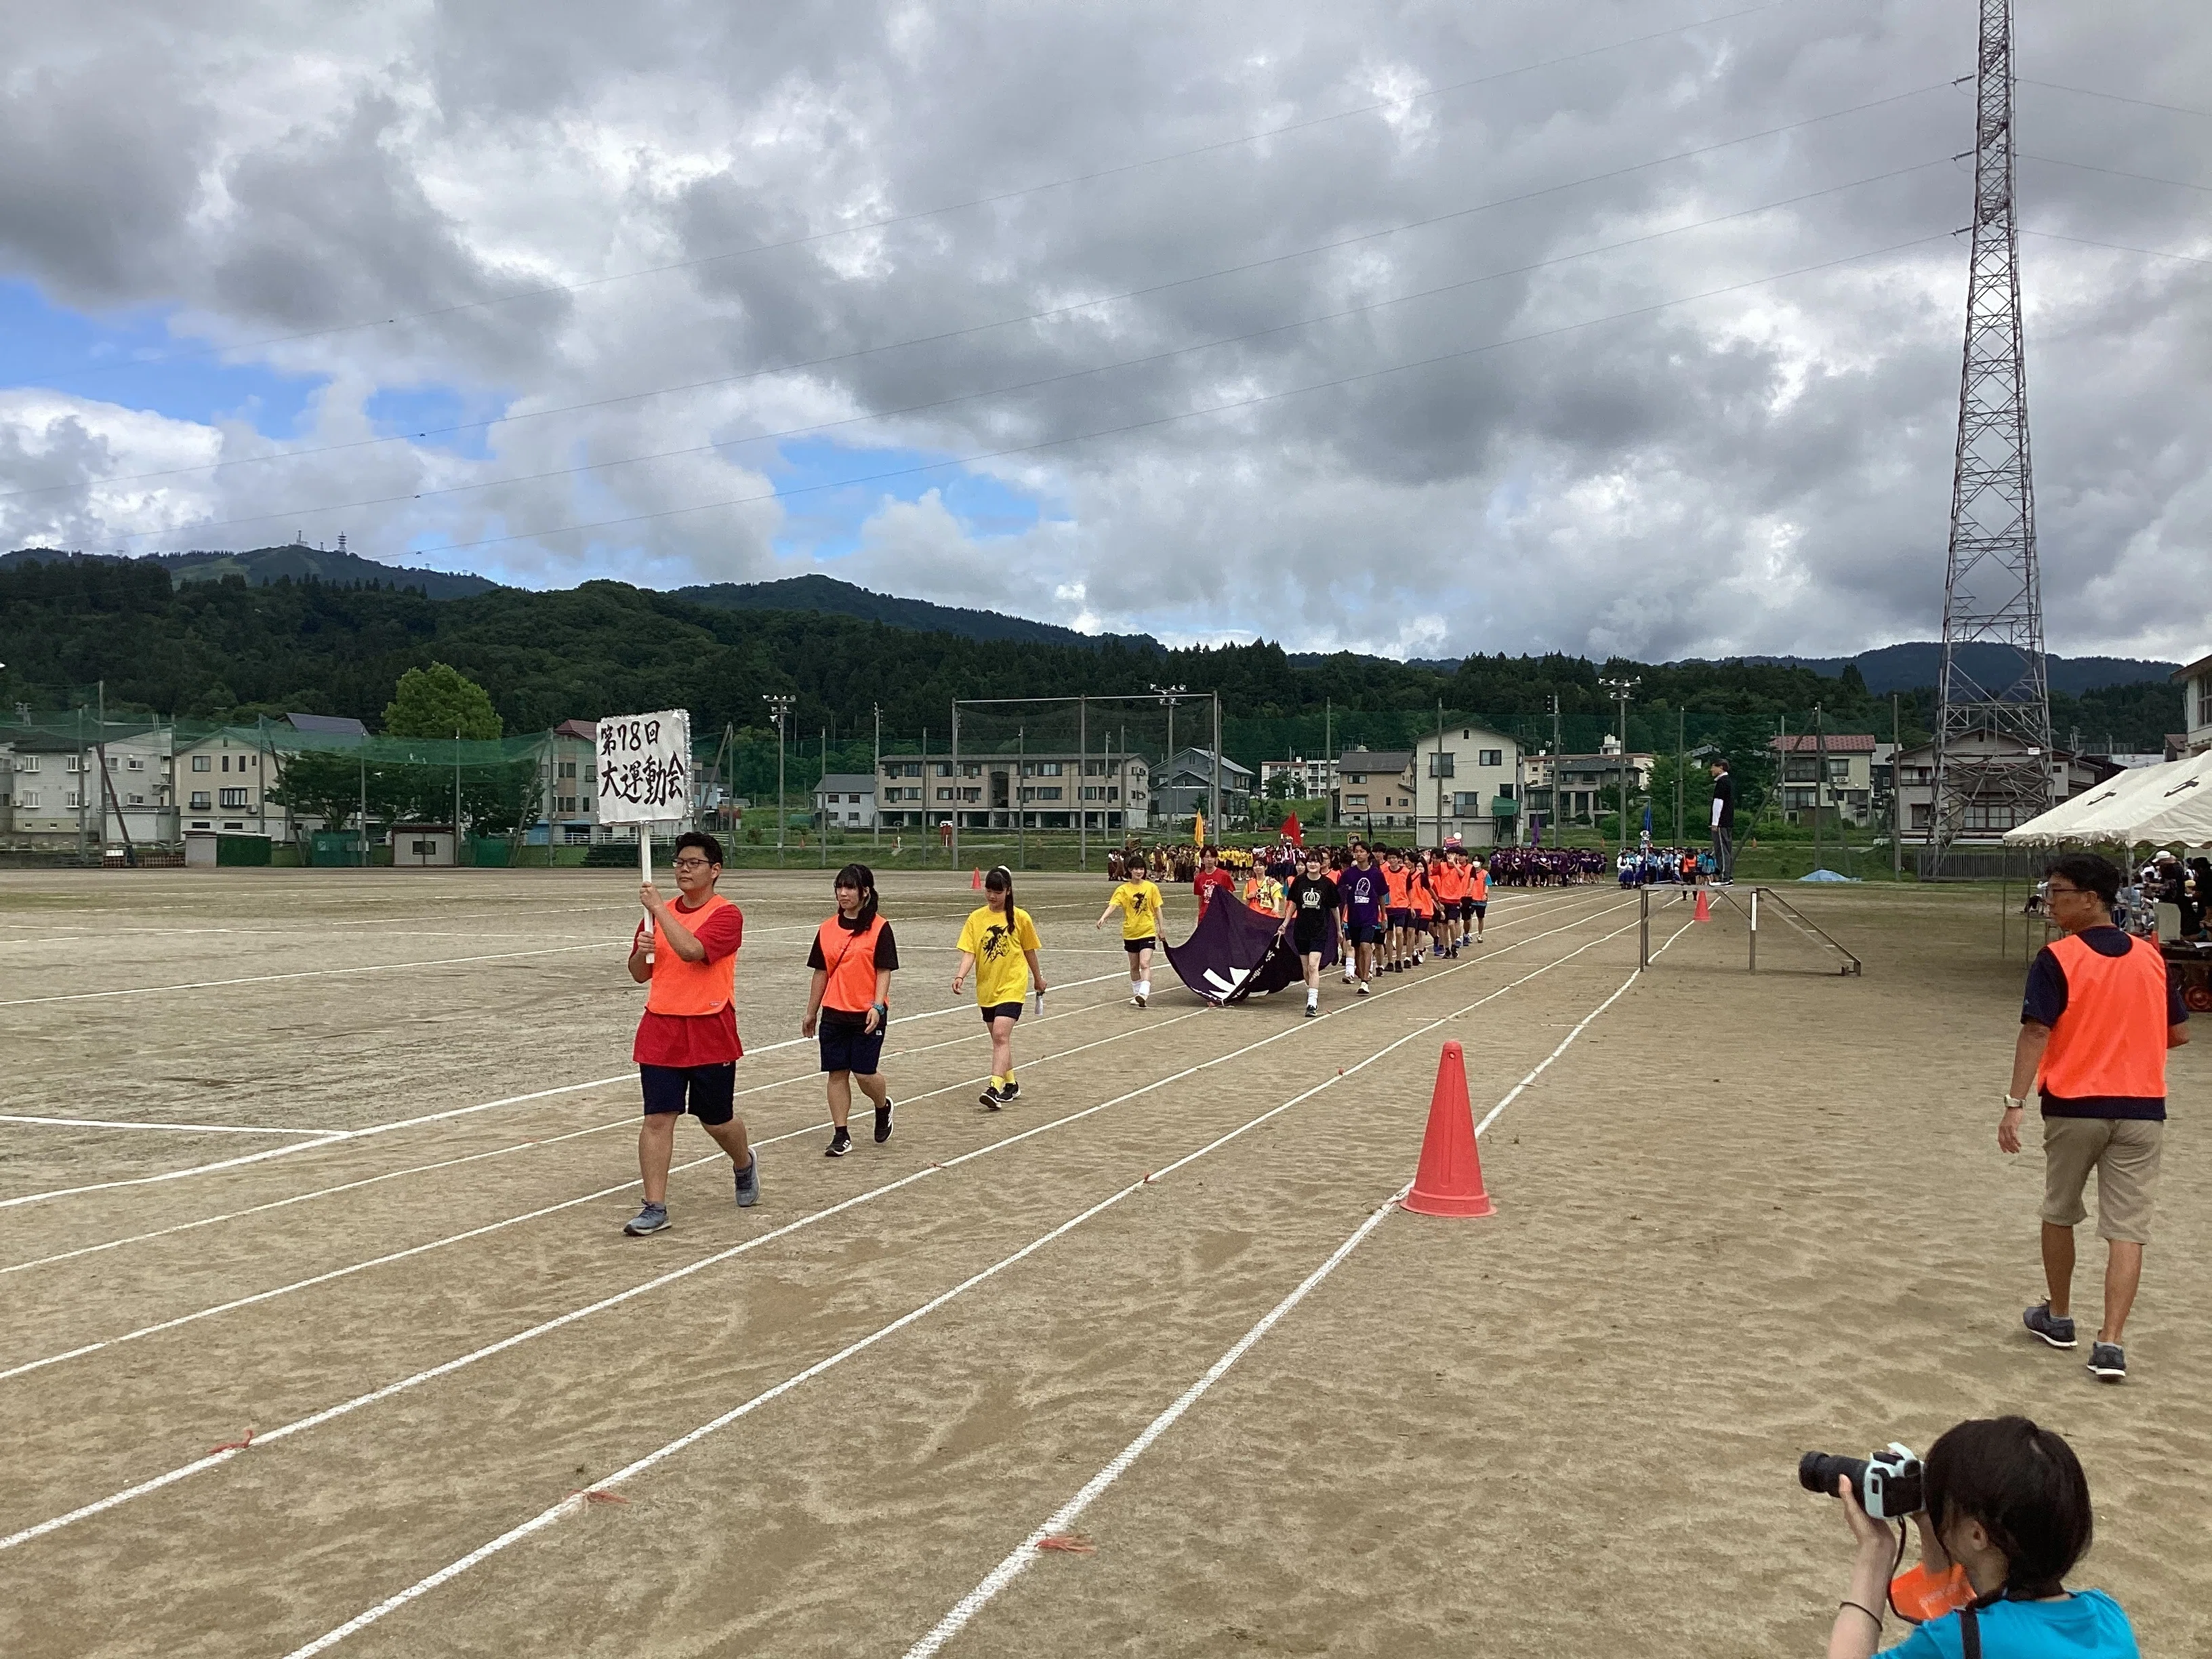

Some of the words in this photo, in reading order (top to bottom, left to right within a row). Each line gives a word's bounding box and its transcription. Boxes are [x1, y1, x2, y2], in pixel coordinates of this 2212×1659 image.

[600, 720, 661, 756] 第78回
[600, 750, 684, 806] 大運動会
